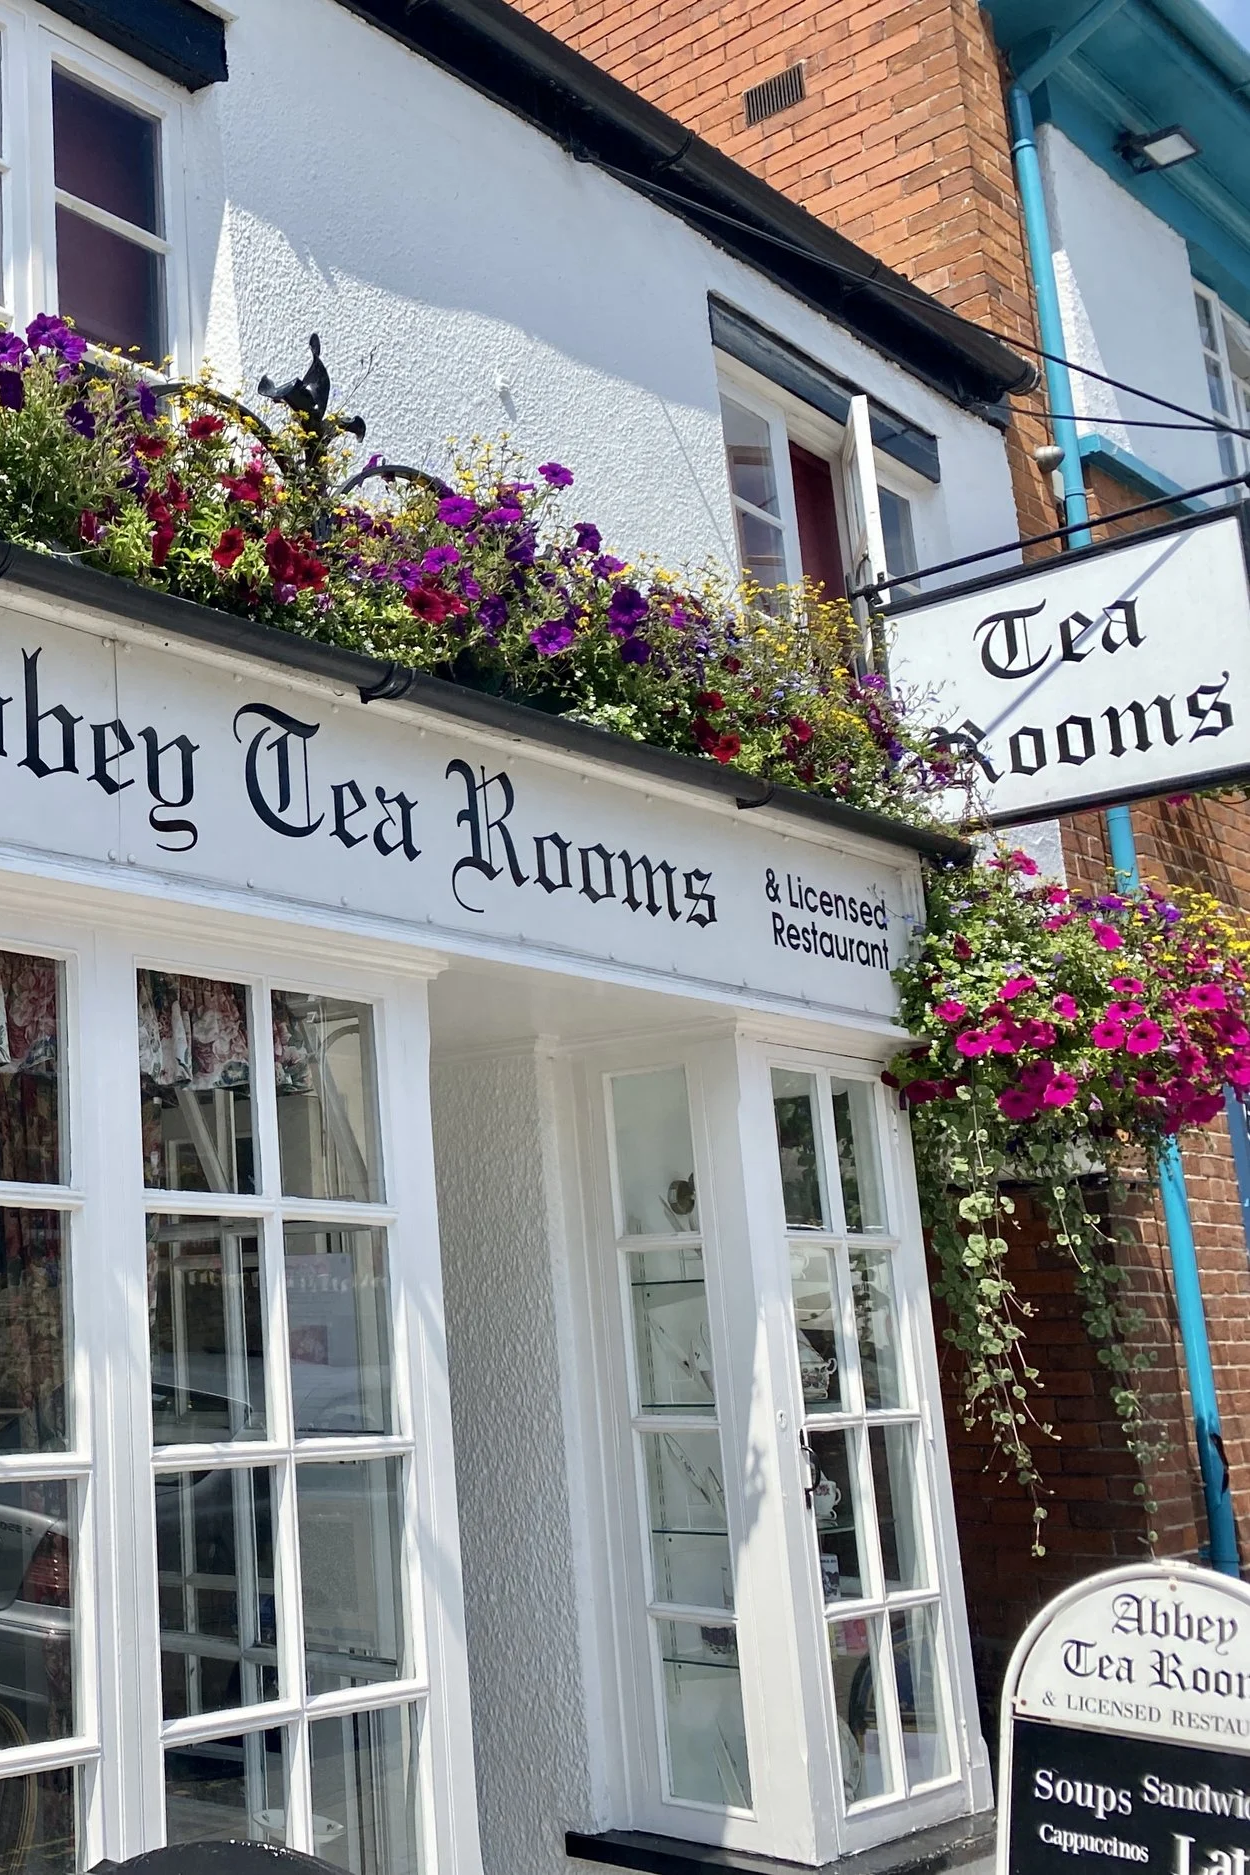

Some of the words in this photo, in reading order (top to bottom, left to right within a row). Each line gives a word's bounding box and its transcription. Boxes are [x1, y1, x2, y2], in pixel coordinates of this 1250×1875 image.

[972, 597, 1147, 680] Tea
[927, 670, 1234, 784] Rooms
[233, 702, 422, 862] Tea
[445, 758, 718, 929] Rooms
[765, 868, 782, 904] &
[787, 874, 888, 931] Licensed
[772, 911, 889, 970] Restaurant
[1112, 1593, 1238, 1656] Abbey
[1061, 1639, 1136, 1684] Tea
[1042, 1691, 1056, 1707] &
[1067, 1694, 1161, 1723] LICENSED
[1034, 1769, 1133, 1820] Soups
[1039, 1824, 1149, 1863] Cappuccinos
